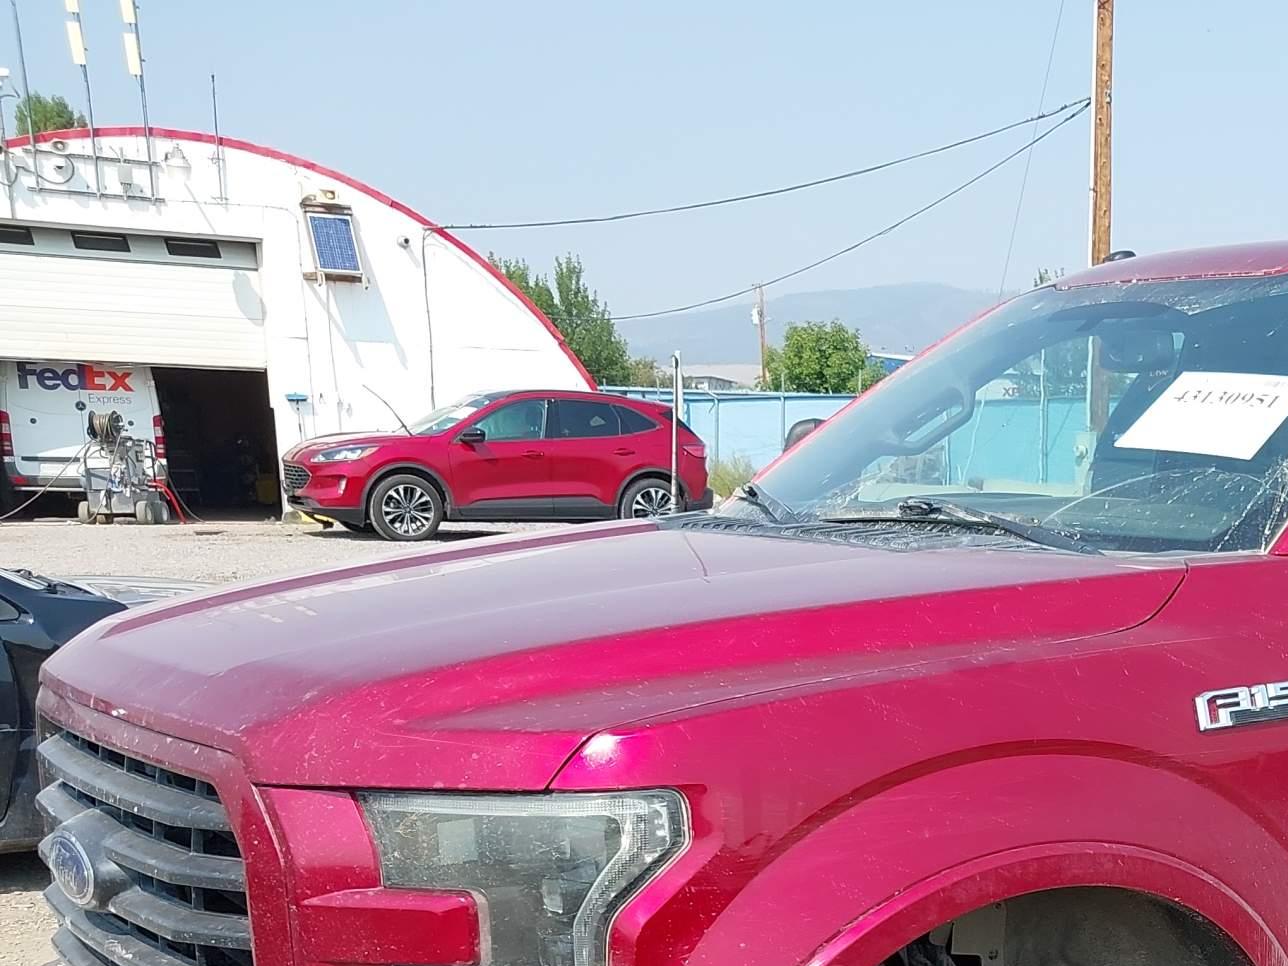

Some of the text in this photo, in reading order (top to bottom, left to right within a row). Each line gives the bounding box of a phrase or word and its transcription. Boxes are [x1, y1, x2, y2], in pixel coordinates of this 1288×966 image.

[16, 361, 135, 392] FedEx
[88, 393, 132, 405] Express
[1174, 390, 1281, 409] 43130951
